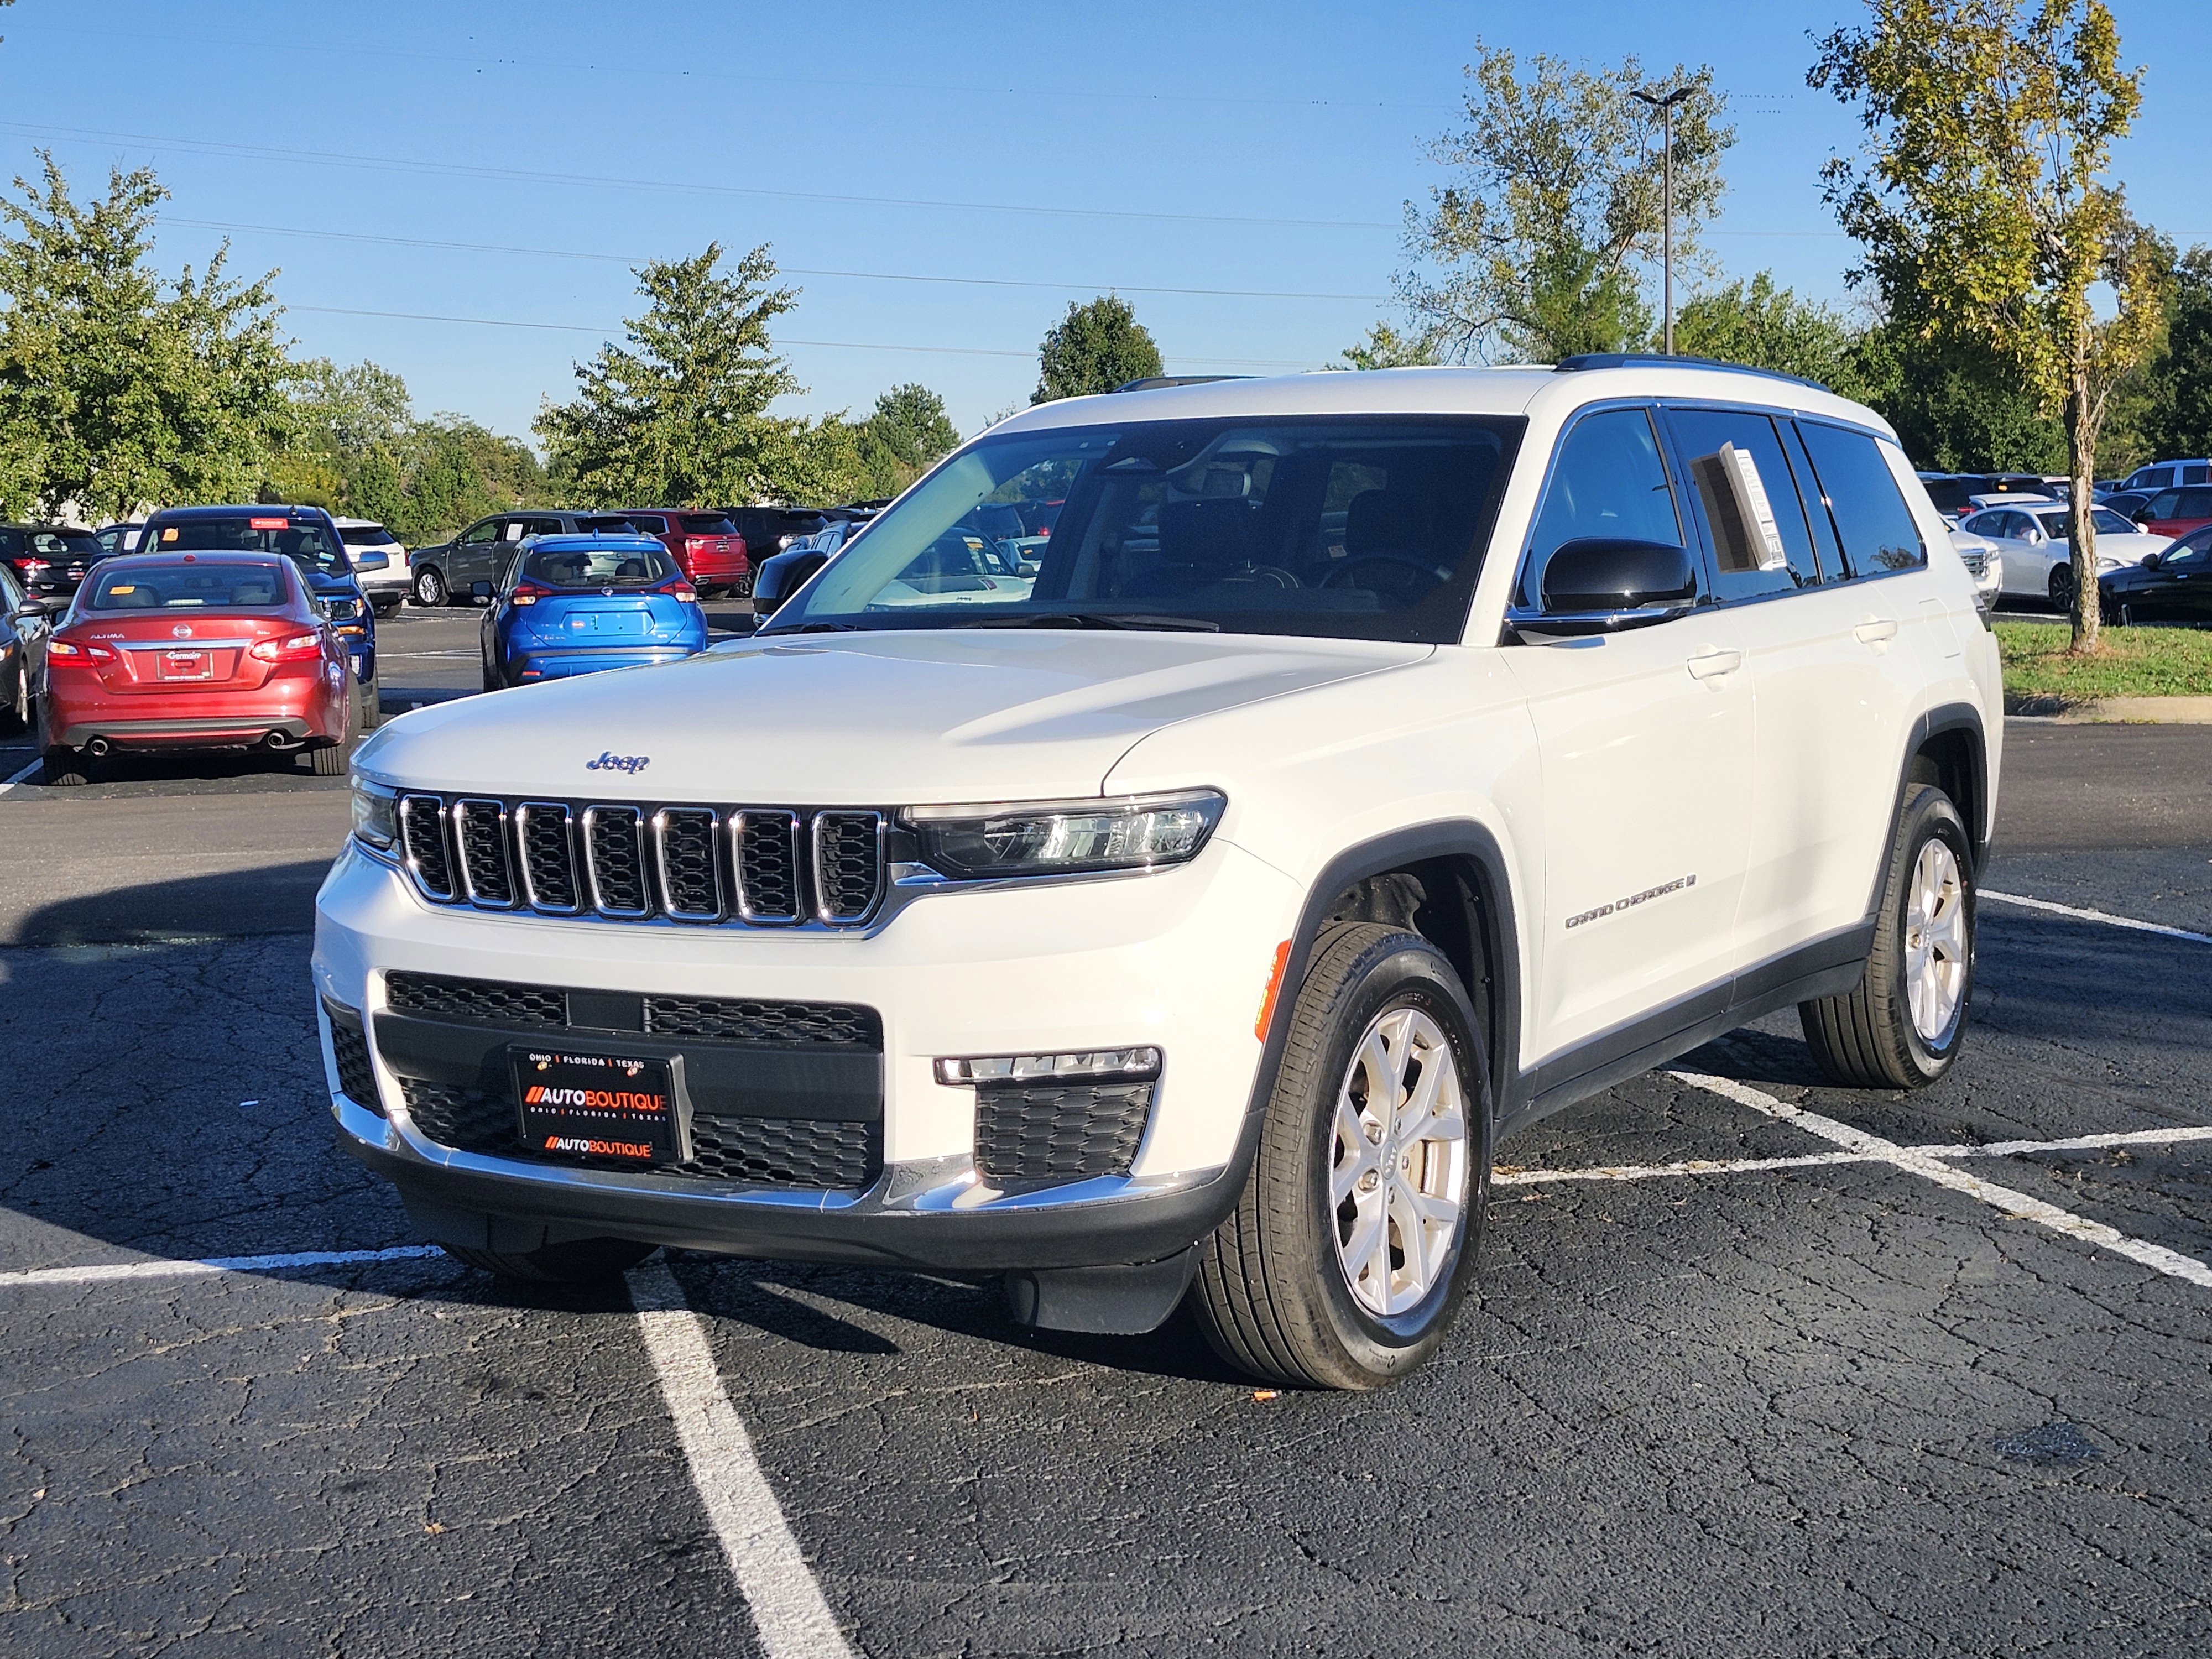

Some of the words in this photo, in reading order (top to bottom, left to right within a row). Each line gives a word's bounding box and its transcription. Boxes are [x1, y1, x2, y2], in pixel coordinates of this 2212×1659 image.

[586, 751, 650, 775] Jeep
[1565, 904, 1614, 930] GRAND
[1615, 878, 1685, 911] CHEROKEE
[529, 1053, 552, 1062] OHIO
[562, 1056, 606, 1066] FLORIDA
[615, 1058, 645, 1069] TEXAS
[540, 1087, 667, 1111] AUTOBOUTIQUE
[530, 1106, 557, 1114] OHIO
[568, 1109, 617, 1118] FLORIDA
[631, 1113, 667, 1122] TEXAS
[556, 1138, 652, 1157] AUTOBOUTIQUE
